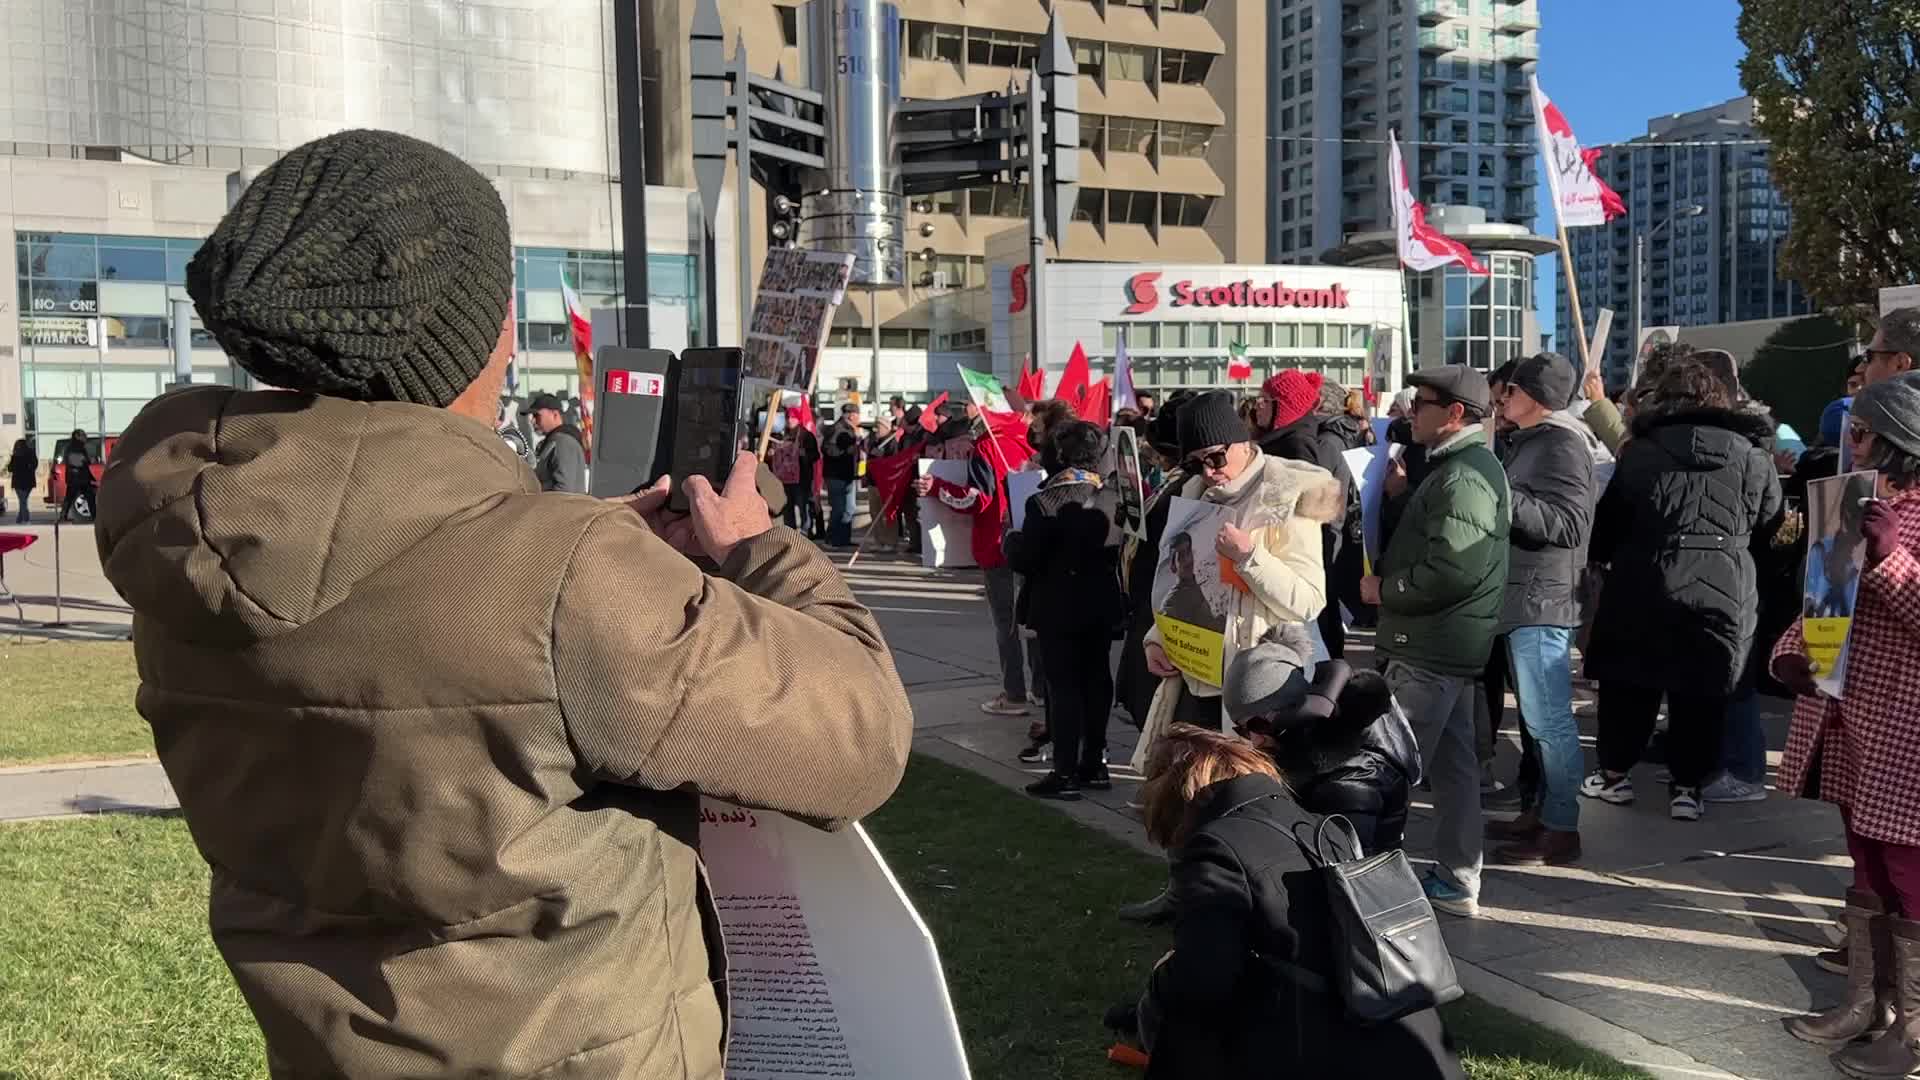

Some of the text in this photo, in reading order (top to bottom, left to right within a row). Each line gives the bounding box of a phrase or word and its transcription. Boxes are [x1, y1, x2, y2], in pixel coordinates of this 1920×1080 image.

[1174, 278, 1350, 309] Scotiabank
[33, 298, 96, 312] NO ONE
[721, 806, 757, 828] زنده
